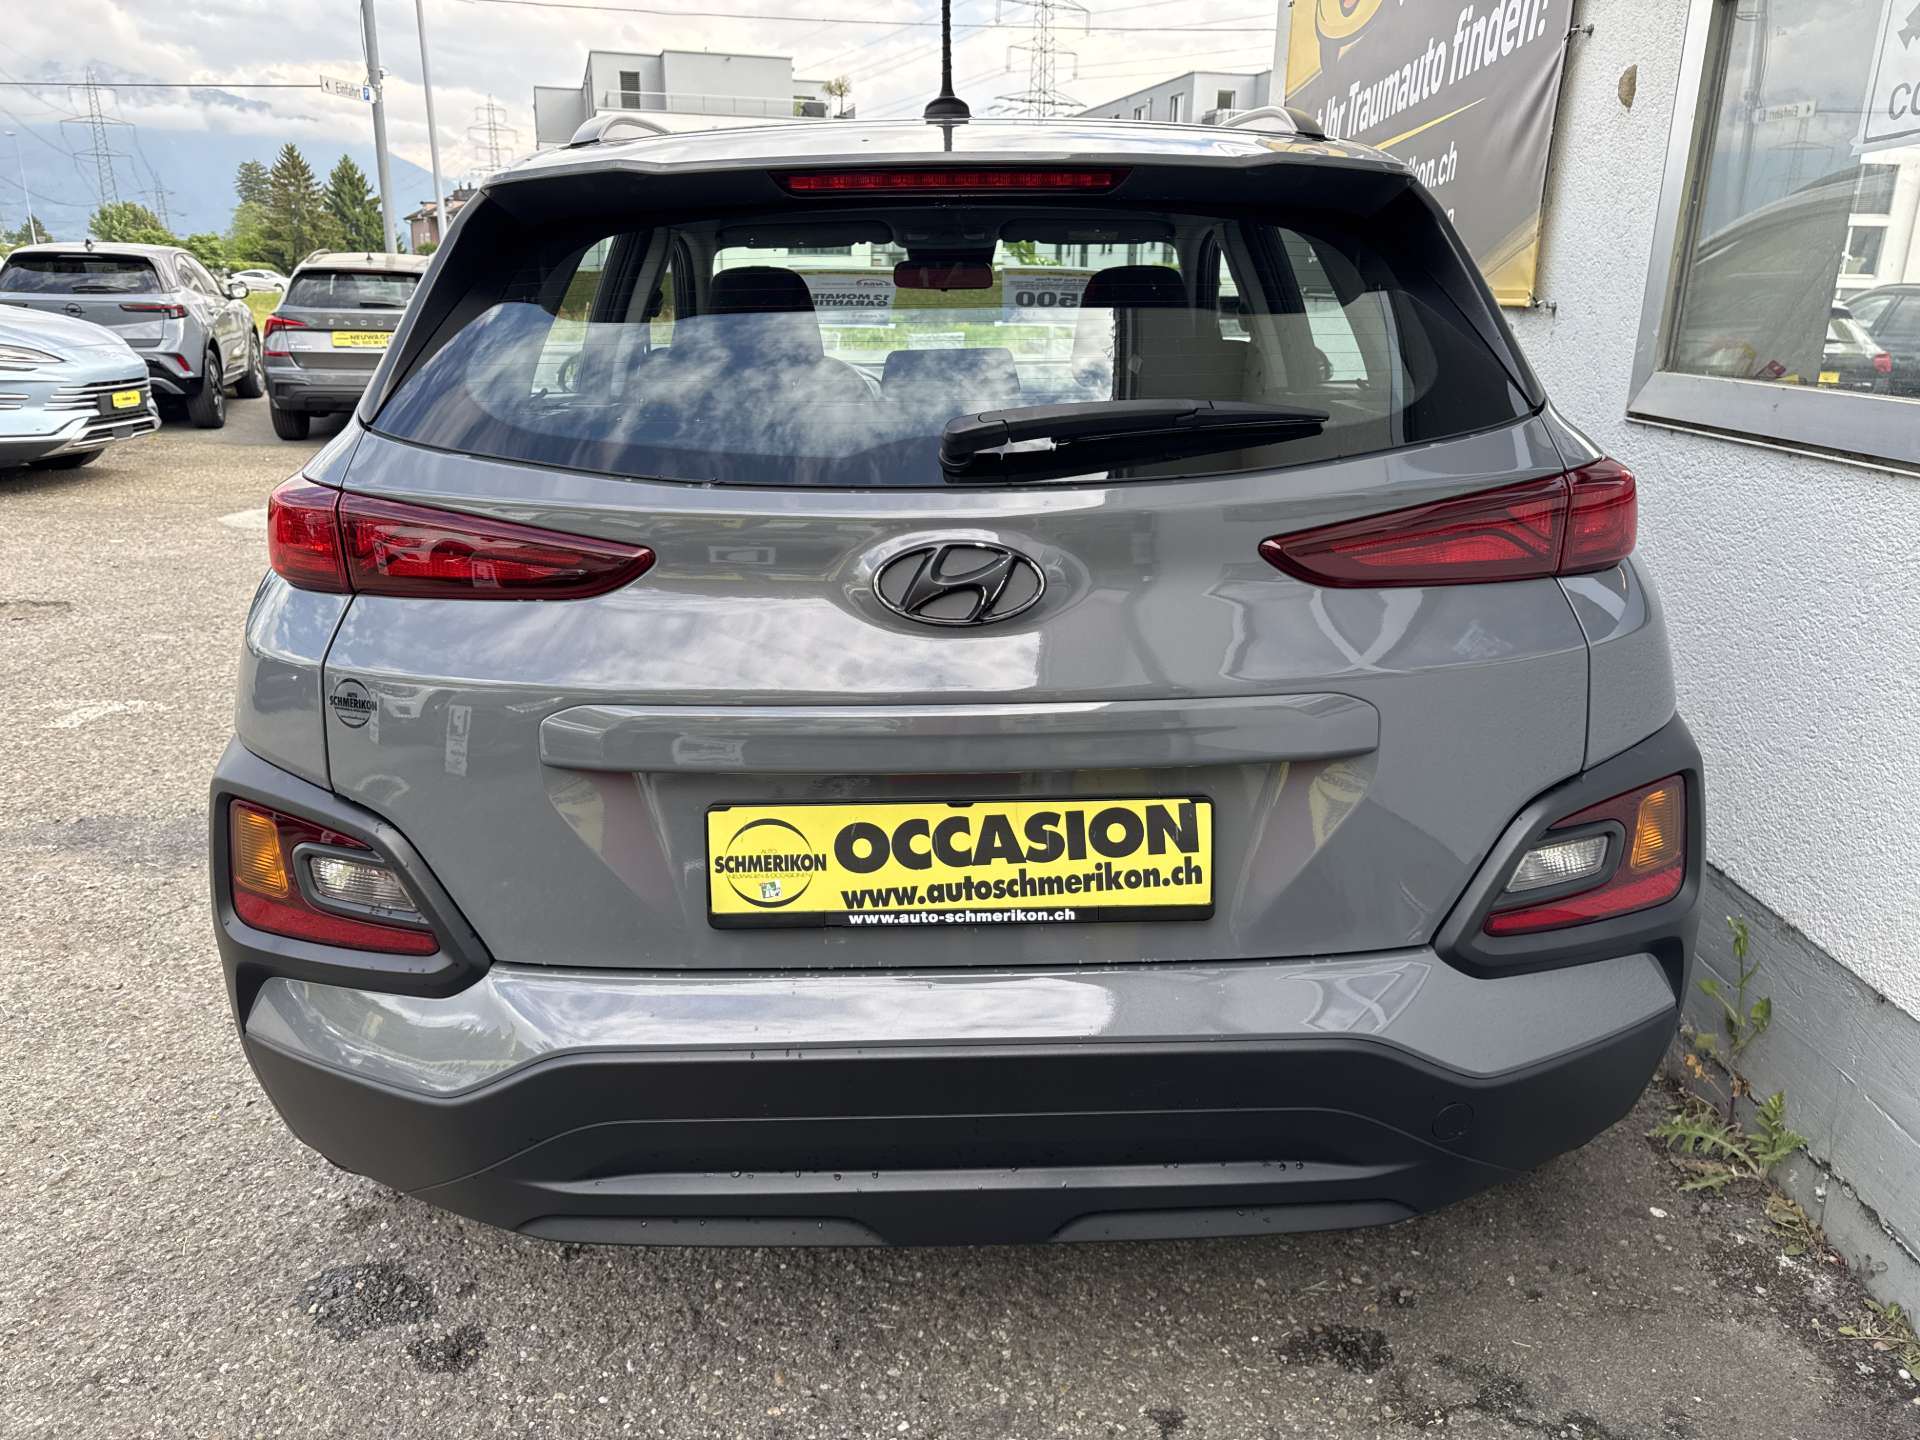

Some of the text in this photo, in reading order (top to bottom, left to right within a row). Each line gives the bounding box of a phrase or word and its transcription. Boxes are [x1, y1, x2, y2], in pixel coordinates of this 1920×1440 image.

[1346, 37, 1447, 139] Traumauto
[329, 695, 378, 712] SCHMERIKON
[834, 803, 1200, 874] OCCASION
[714, 853, 827, 874] SCHMERIKON
[840, 856, 1202, 909] www.autoschmerikon.ch
[848, 908, 1076, 924] www.auto-schmerikon.ch
